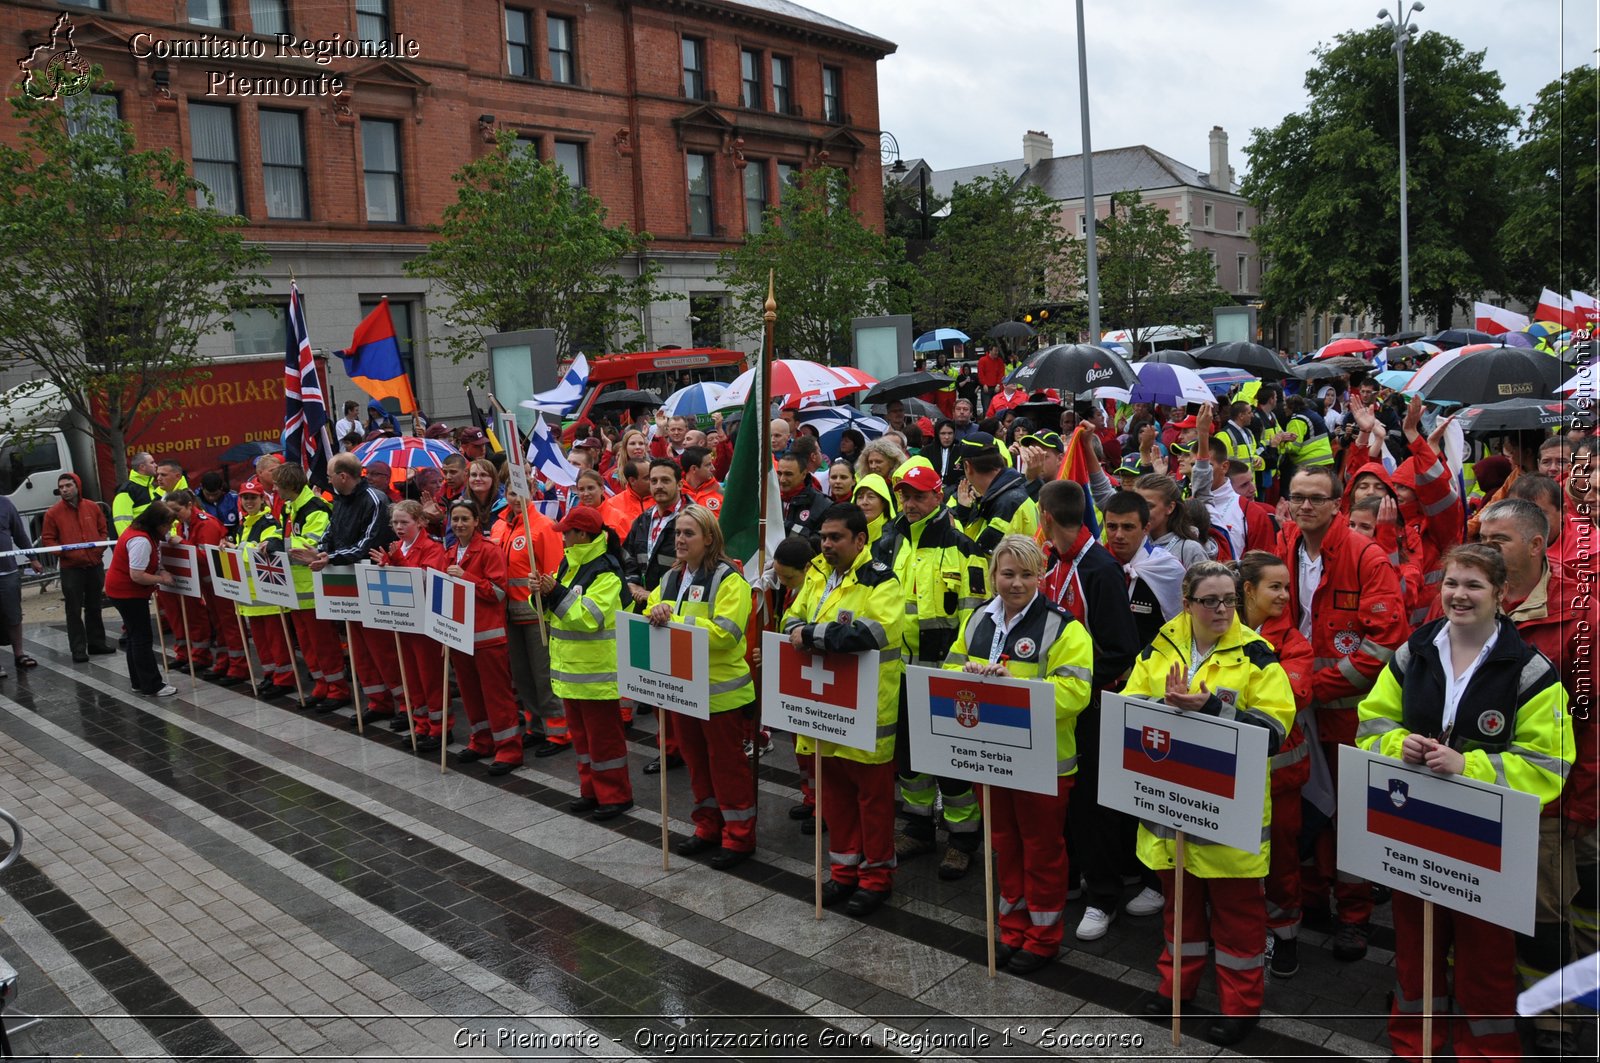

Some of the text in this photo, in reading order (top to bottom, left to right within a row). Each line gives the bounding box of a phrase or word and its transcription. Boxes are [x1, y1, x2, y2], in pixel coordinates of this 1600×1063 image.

[1086, 367, 1113, 383] Bass
[126, 438, 201, 457] RANSPORT
[206, 435, 231, 448] LTD
[391, 610, 409, 618] Finland
[436, 618, 458, 633] Team France
[449, 633, 462, 643] France
[638, 675, 684, 693] Team Ireland
[627, 684, 655, 699] Foireann
[667, 692, 698, 709] hÉireann
[781, 701, 855, 725] Team Switzerland
[788, 715, 847, 737] Team Schweiz
[951, 745, 1012, 763] Team Serbia
[951, 758, 985, 772] Србија
[1133, 781, 1220, 815] Team Slovakia
[1158, 803, 1219, 831] Slovensko
[1384, 846, 1480, 886] Team Slovenia
[1382, 861, 1482, 903] Team Slovenija
